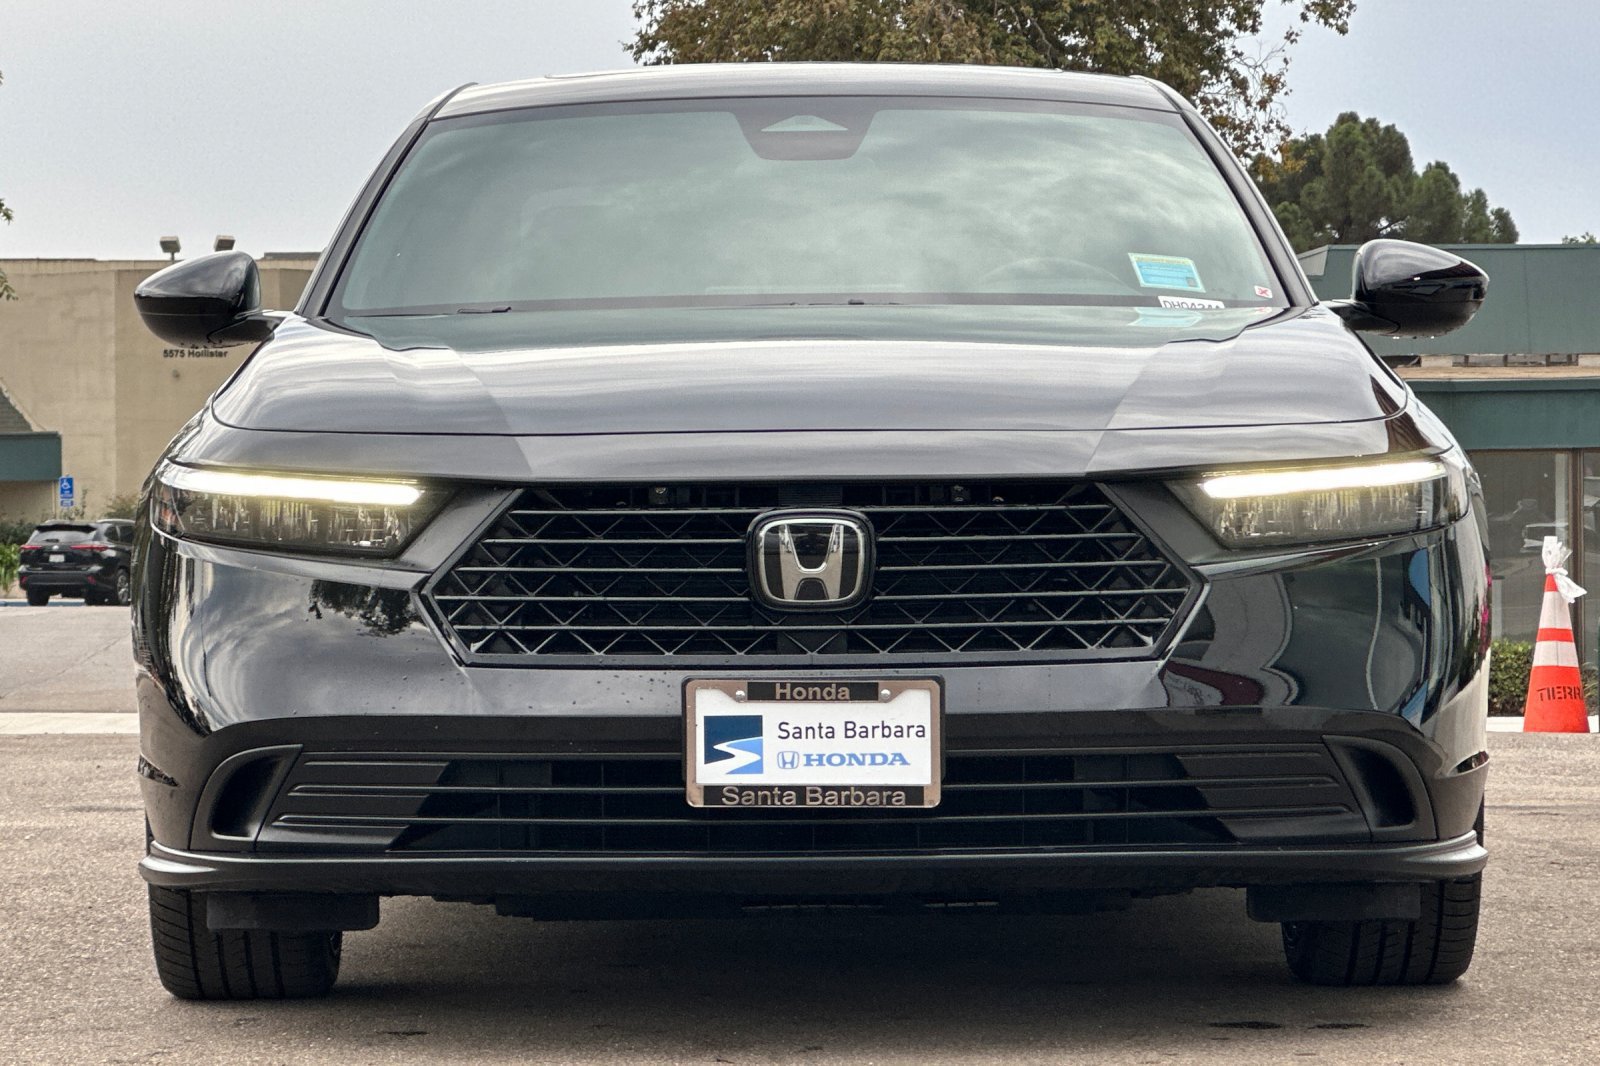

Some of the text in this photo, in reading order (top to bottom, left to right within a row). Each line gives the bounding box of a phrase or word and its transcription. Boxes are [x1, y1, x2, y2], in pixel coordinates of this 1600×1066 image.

[163, 350, 228, 358] 5575 Hollister
[775, 683, 851, 701] Honda
[1536, 685, 1583, 701] TIERR
[777, 720, 927, 740] Santa Barbara
[803, 752, 911, 767] HONDA
[721, 786, 907, 806] Santa Barbara
